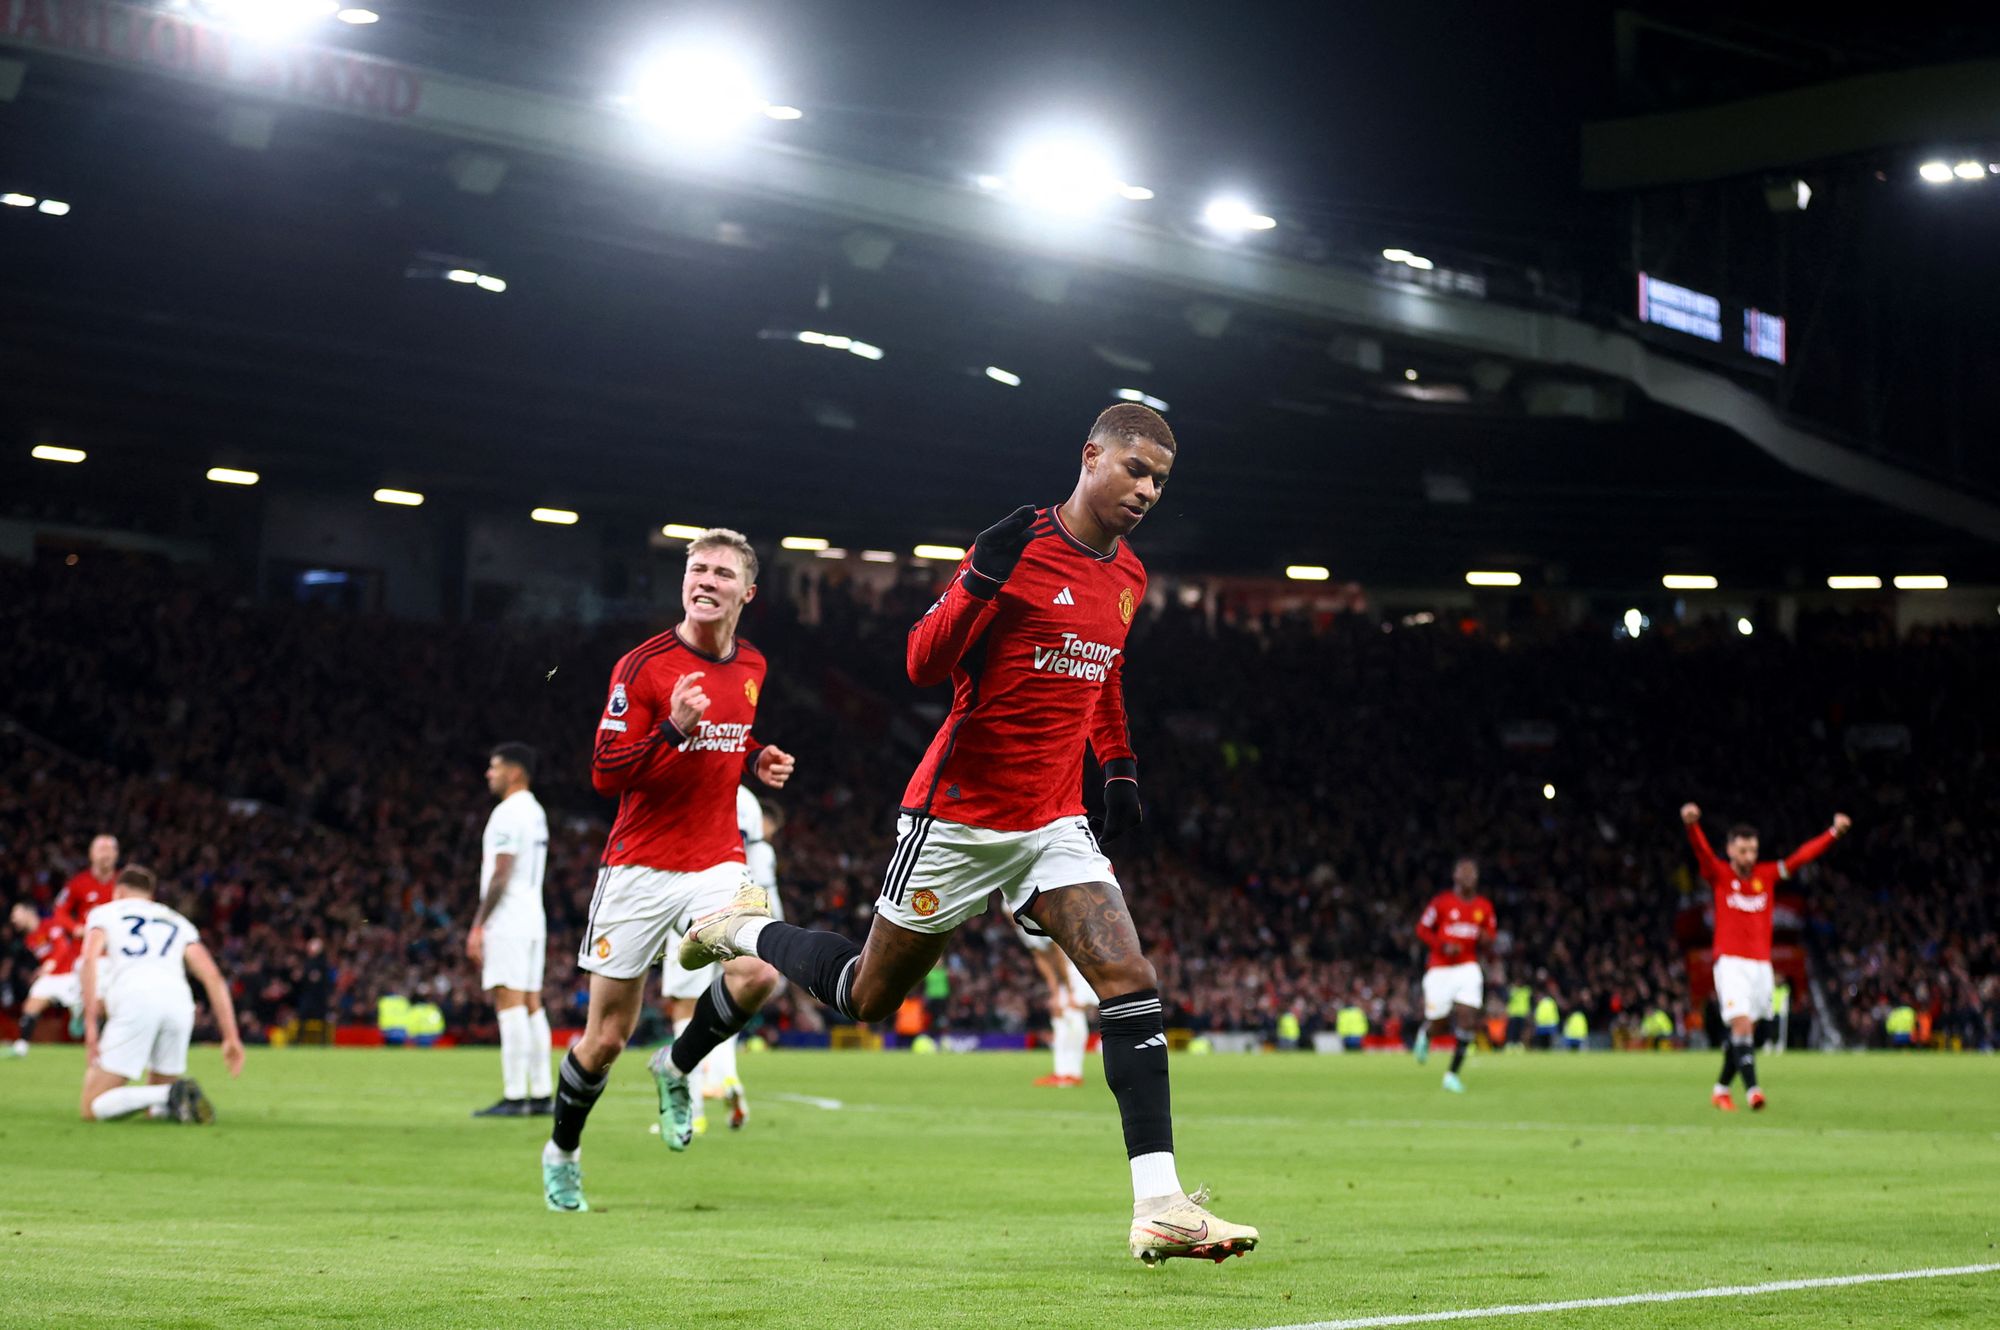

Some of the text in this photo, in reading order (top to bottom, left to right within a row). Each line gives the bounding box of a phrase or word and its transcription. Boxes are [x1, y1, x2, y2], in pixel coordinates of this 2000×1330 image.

[1033, 646, 1103, 682] Viewer
[1061, 632, 1111, 663] Team
[697, 720, 742, 738] Team
[121, 915, 179, 957] 37
